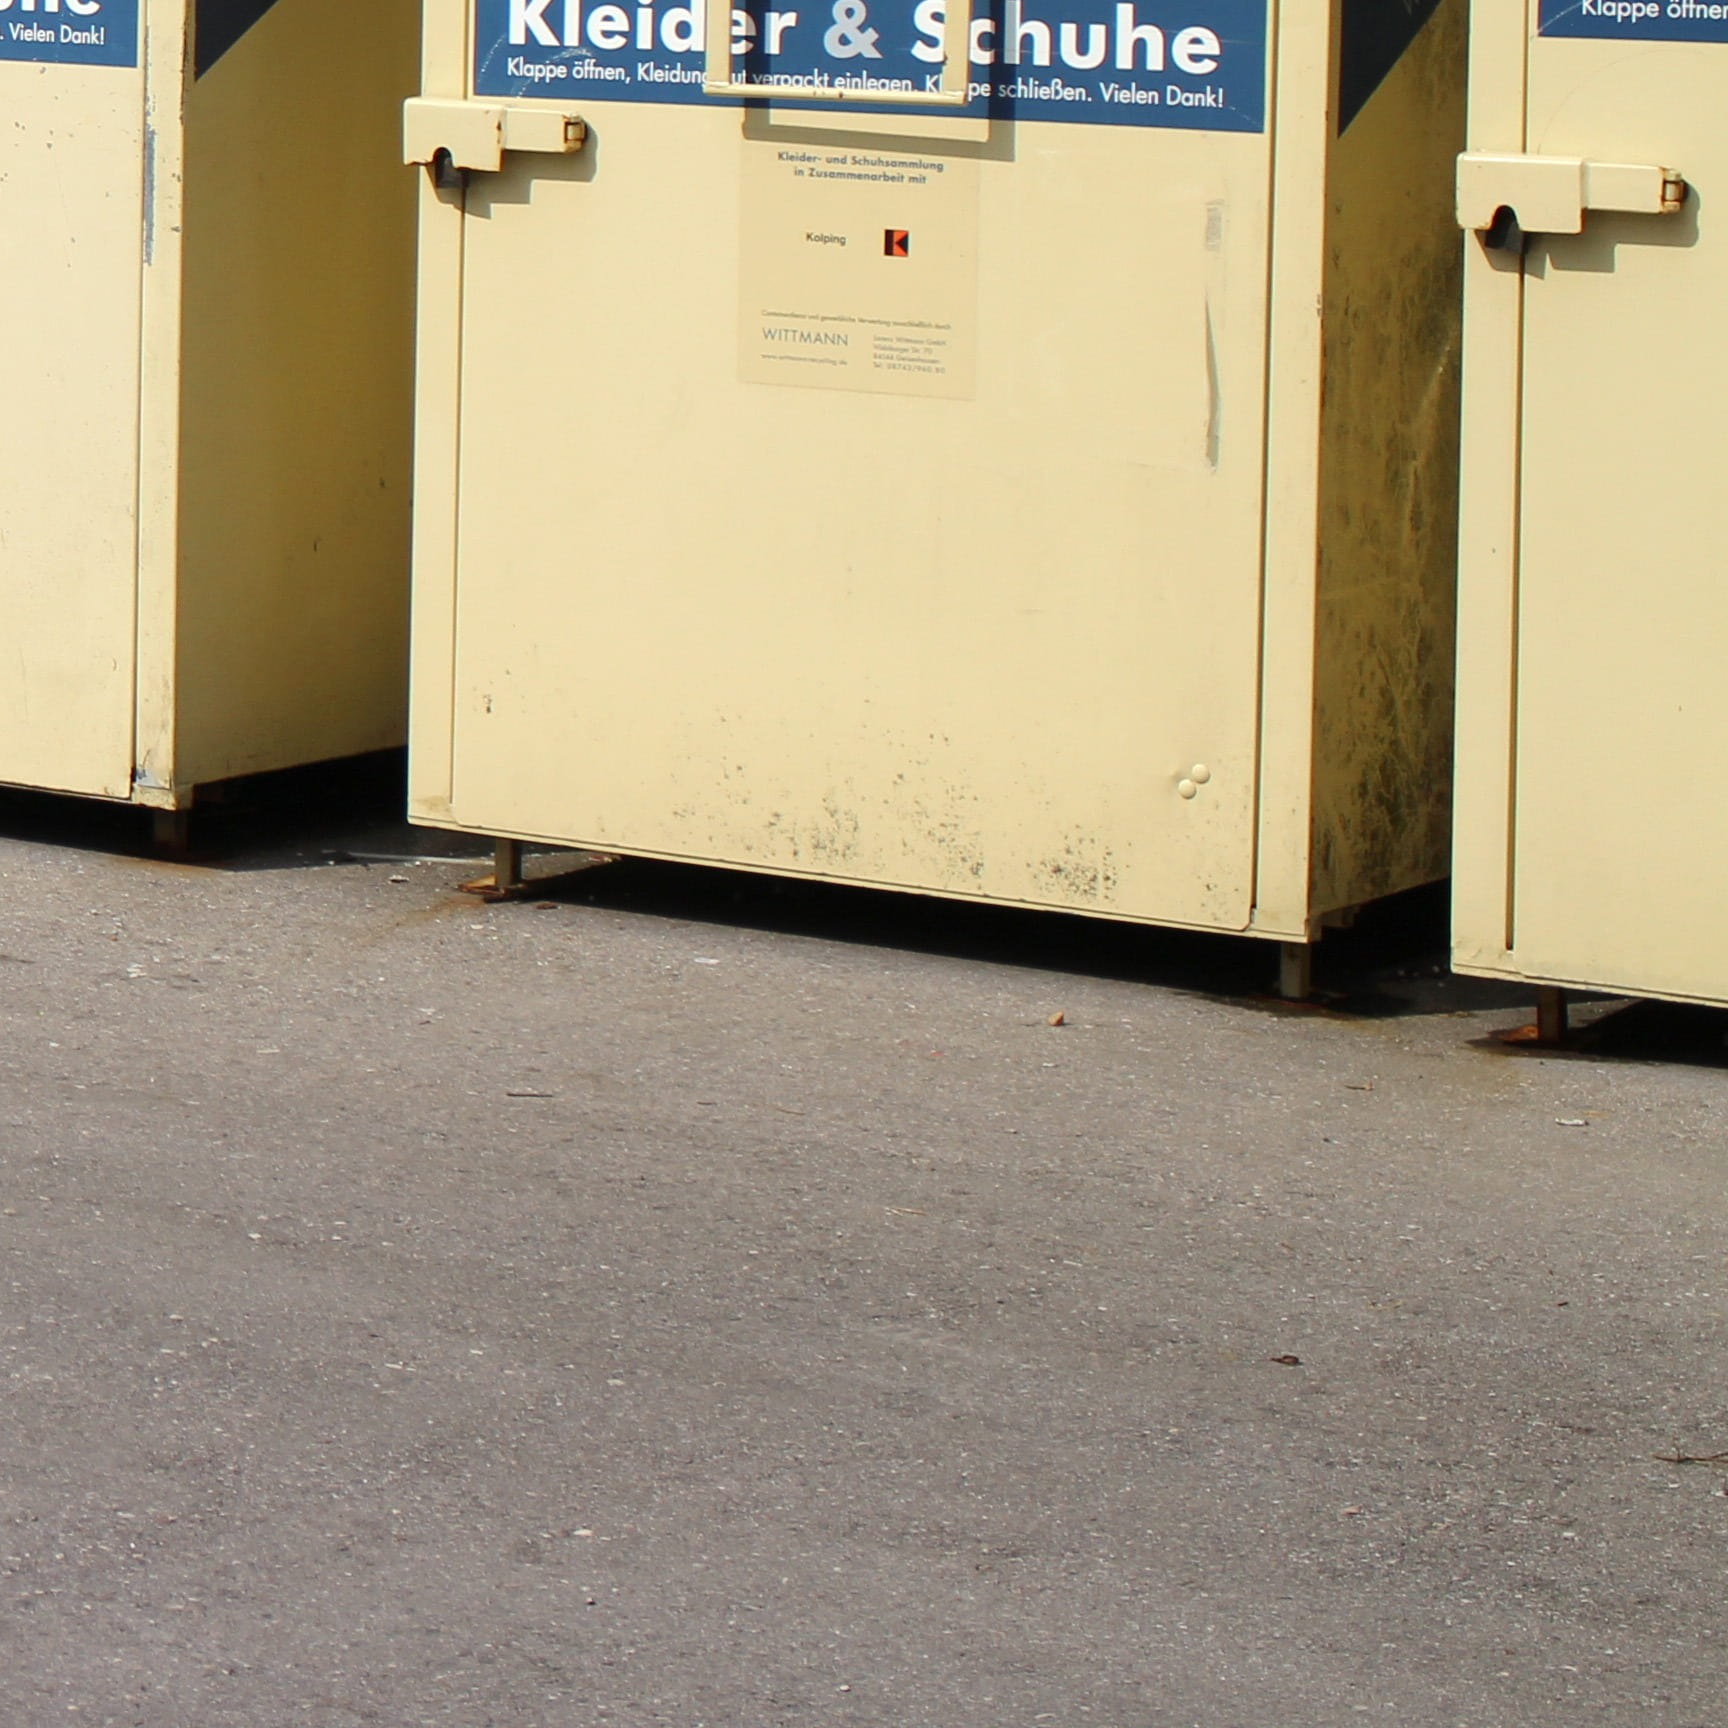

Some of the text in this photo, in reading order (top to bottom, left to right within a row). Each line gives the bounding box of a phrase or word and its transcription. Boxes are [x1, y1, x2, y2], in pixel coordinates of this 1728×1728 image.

[9, 22, 55, 43] Vielen
[60, 24, 105, 45] Dank!
[507, 57, 568, 83] Klappe
[572, 59, 631, 85] öffnen,
[752, 69, 830, 89] verpackt
[998, 76, 1092, 103] schließen.
[1099, 82, 1159, 105] Vielen
[1166, 85, 1225, 108] Dank!
[777, 152, 945, 173] Kleider- und Schuhsammlung
[794, 166, 927, 184] in Zusammenarbeit mit
[805, 232, 846, 246] Kolping
[761, 327, 849, 346] WITTMANN
